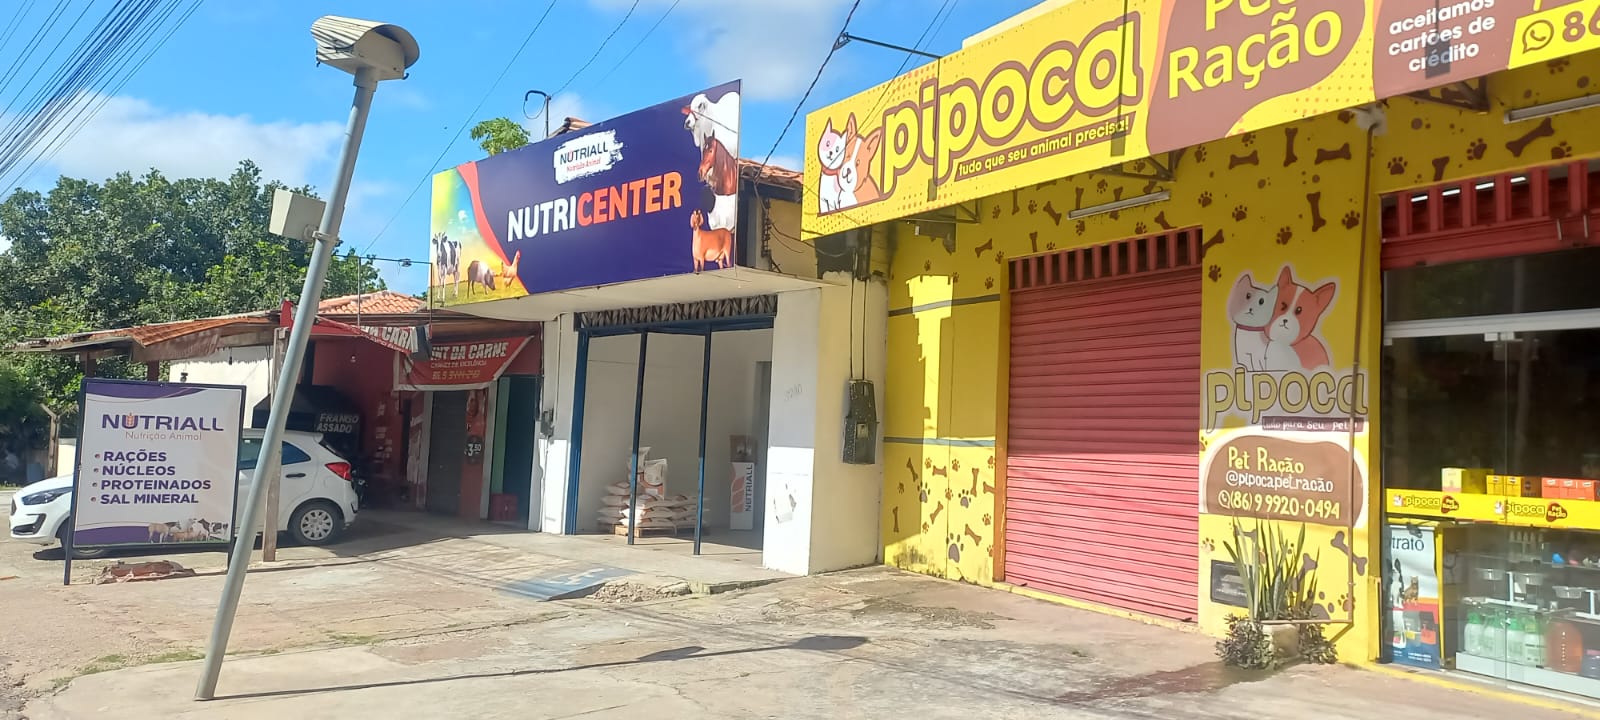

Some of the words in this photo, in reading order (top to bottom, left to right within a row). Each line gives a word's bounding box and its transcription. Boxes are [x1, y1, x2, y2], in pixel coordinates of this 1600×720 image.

[1388, 28, 1463, 56] cartões
[1468, 16, 1496, 35] de
[1168, 7, 1342, 99] Ração
[1408, 43, 1480, 72] crédito
[882, 14, 1142, 198] pipoca
[559, 140, 609, 166] NUTRIALL
[958, 156, 983, 177] tudo
[984, 151, 1006, 172] que
[1007, 148, 1028, 163] seu
[1030, 132, 1073, 157] animal
[1075, 114, 1130, 147] precisa!
[507, 171, 683, 243] NUTRICENTER
[468, 341, 509, 360] CARNE
[1206, 366, 1369, 434] pipoca
[101, 413, 225, 431] NUTRIALL
[316, 423, 353, 434] ASSADO
[319, 413, 360, 424] FRANGO
[125, 431, 167, 441] Nutrição
[169, 432, 202, 441] Animal
[103, 448, 168, 464] RAÇÕES
[1228, 446, 1251, 470] Pet
[1257, 446, 1305, 476] Ração
[102, 463, 176, 476] NÚCLEOS
[101, 480, 212, 491] PROTEINADOS
[100, 494, 131, 505] SAL
[133, 493, 199, 504] MINERAL
[1230, 490, 1253, 511] (86)
[1254, 493, 1263, 512] 9
